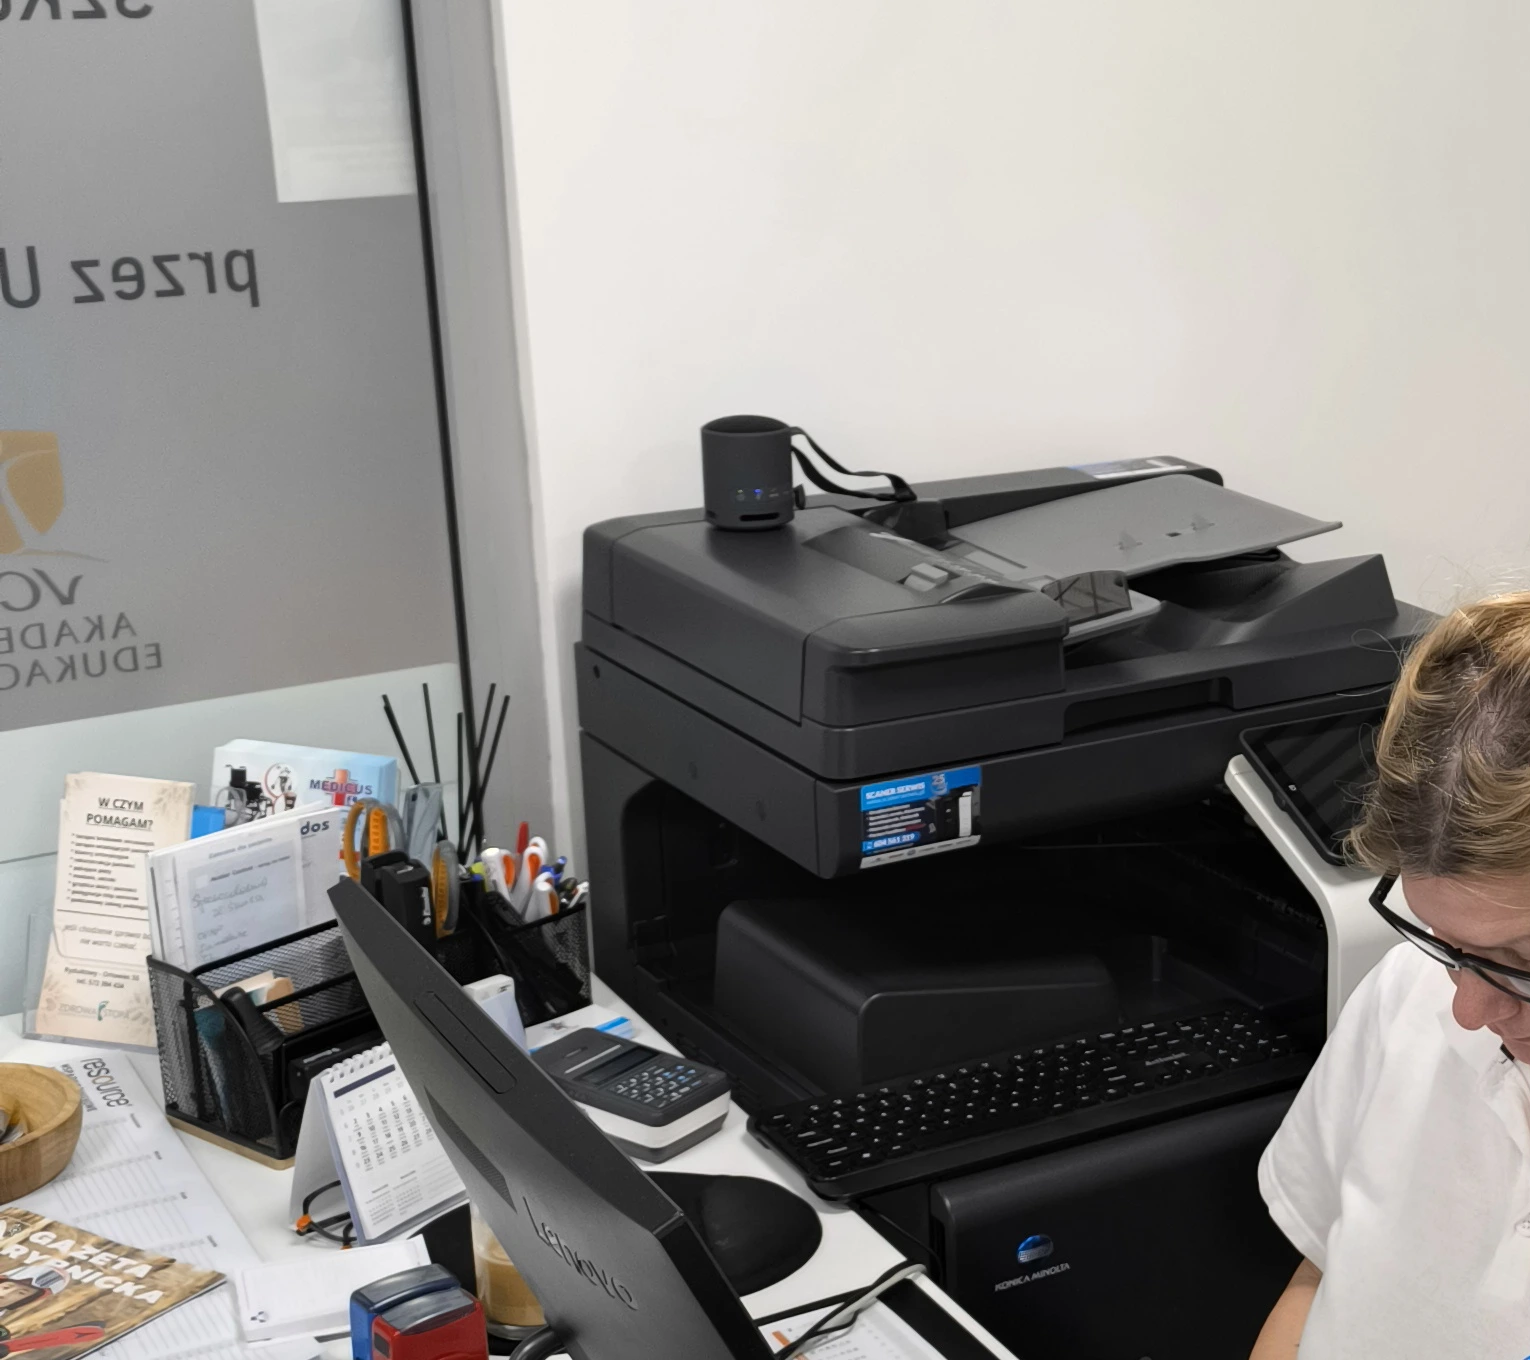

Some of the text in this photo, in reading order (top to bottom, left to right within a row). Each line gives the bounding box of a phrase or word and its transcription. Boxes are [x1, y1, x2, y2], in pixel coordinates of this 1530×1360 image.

[310, 778, 372, 796] MEDICUS
[98, 797, 144, 810] W CZYM
[86, 813, 153, 829] POMAGAM?
[29, 1231, 153, 1278] GAZETA
[995, 1262, 1070, 1292] KONICA MINOLTA
